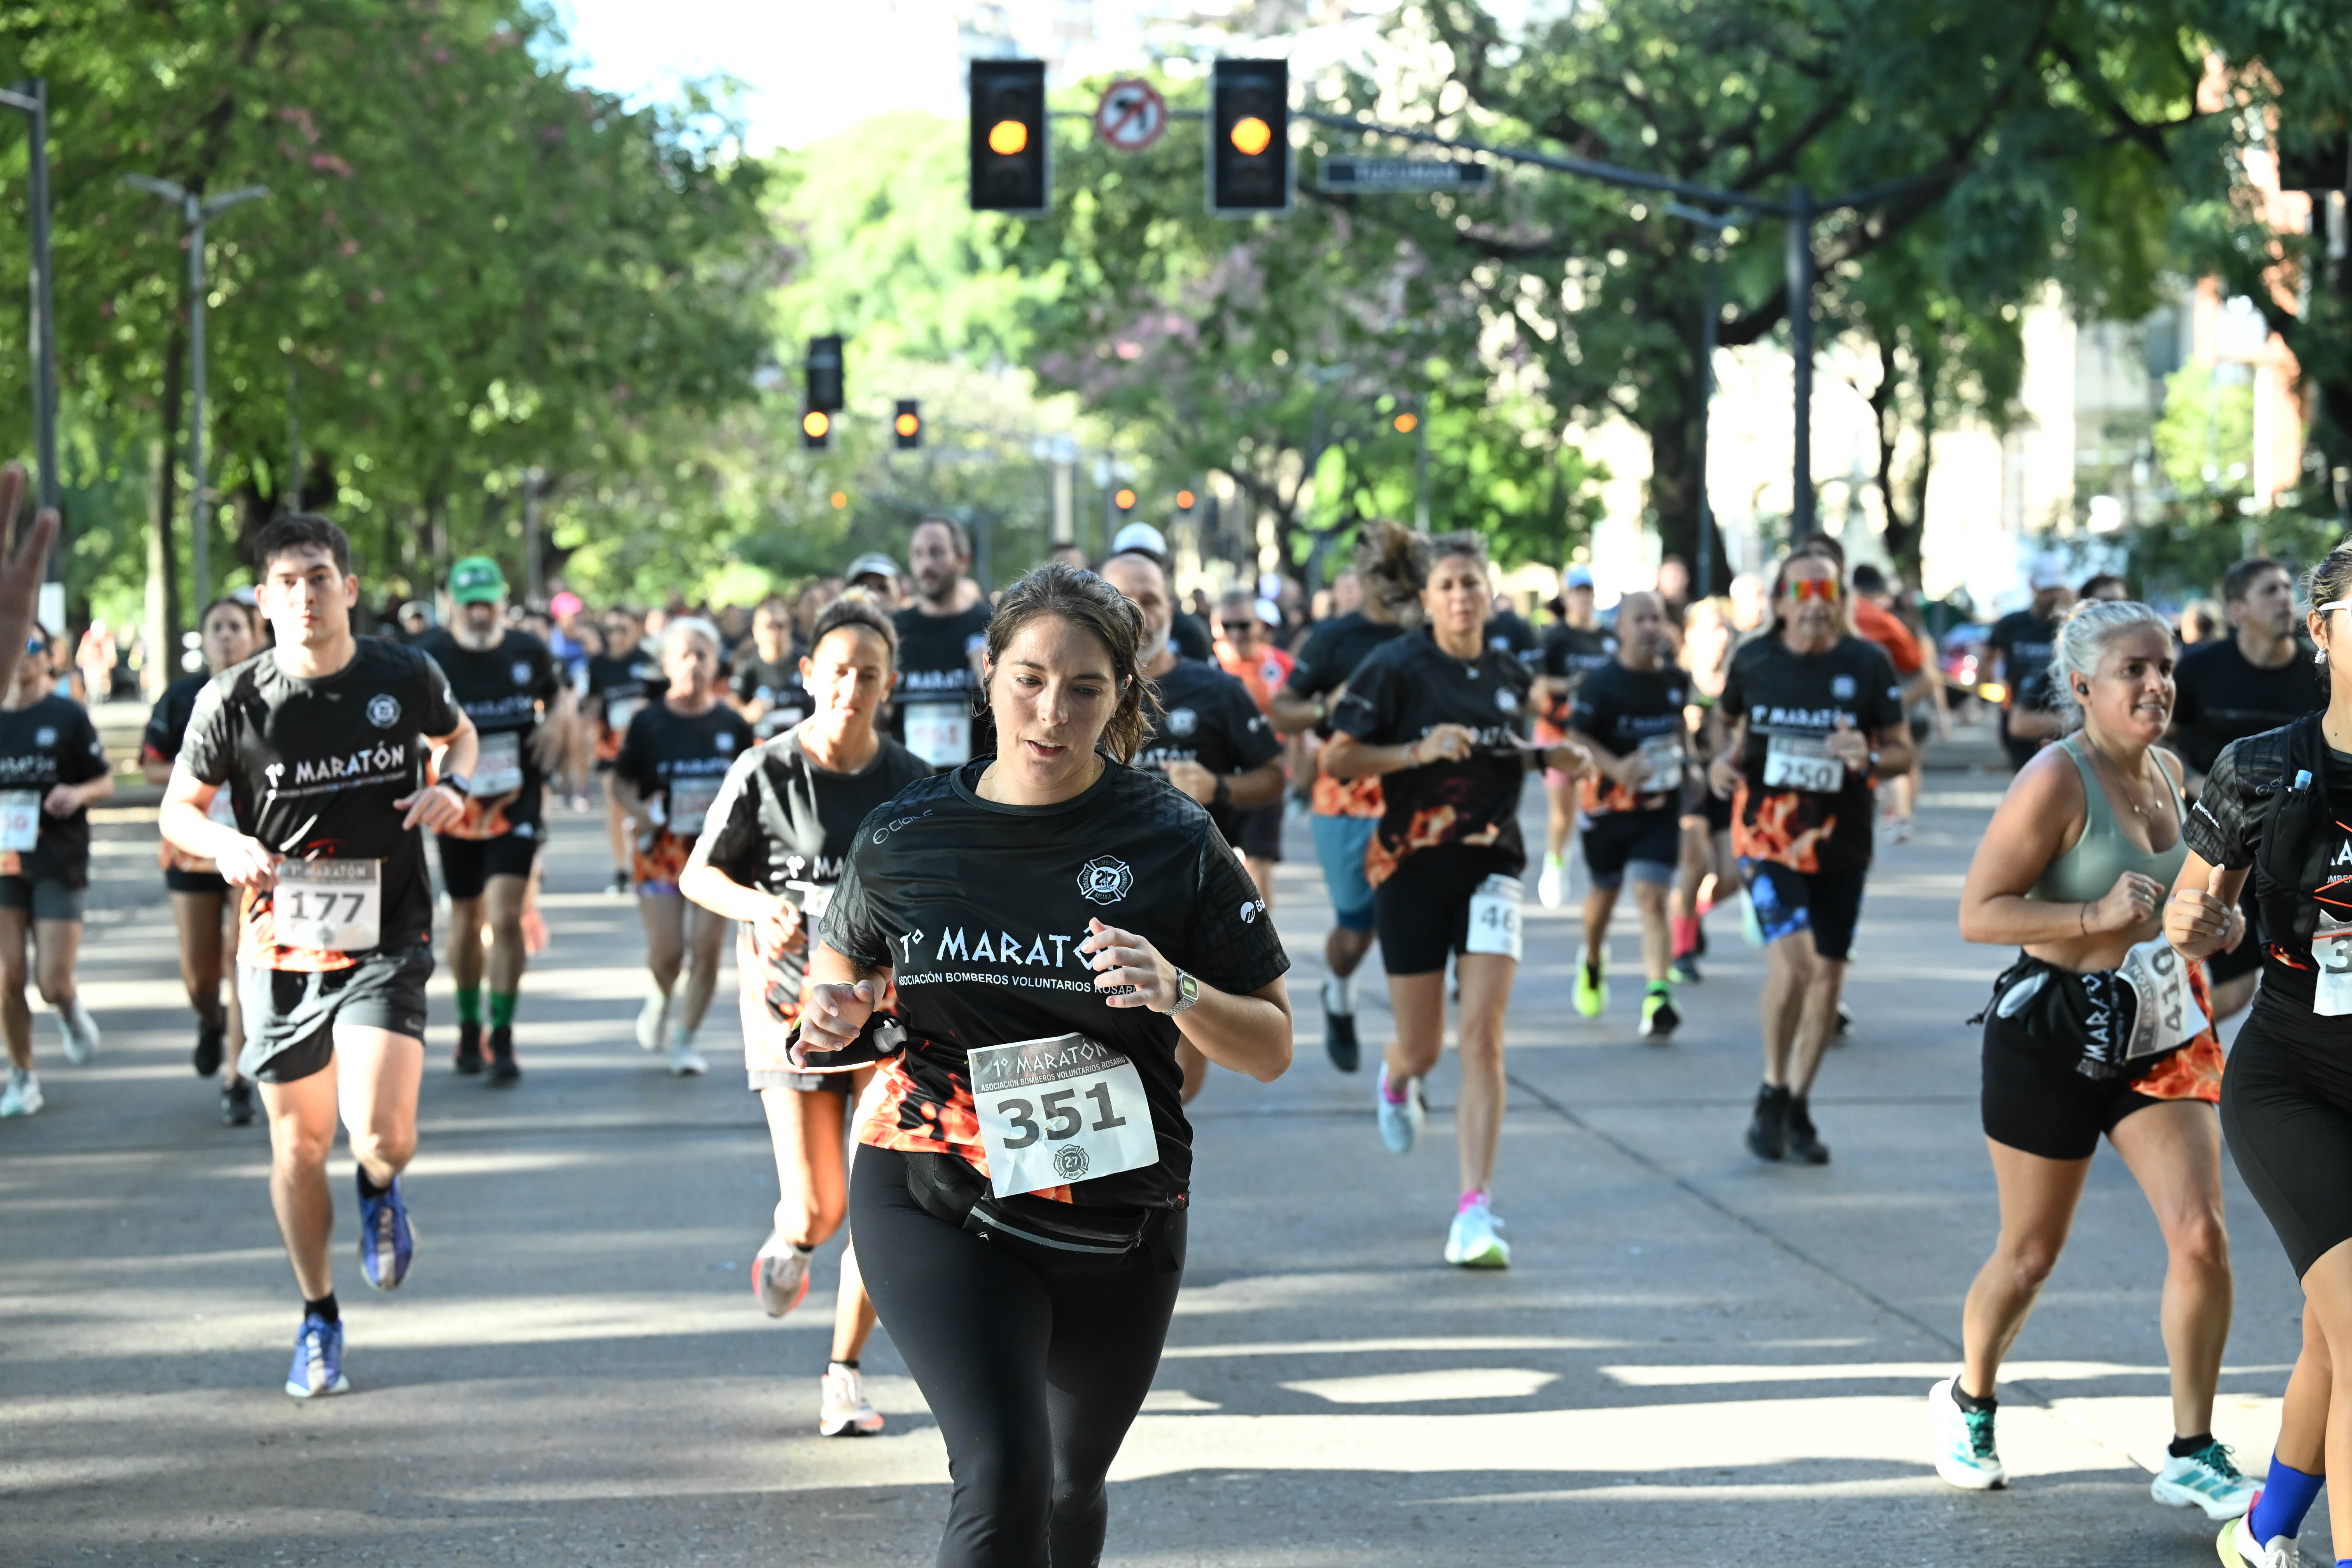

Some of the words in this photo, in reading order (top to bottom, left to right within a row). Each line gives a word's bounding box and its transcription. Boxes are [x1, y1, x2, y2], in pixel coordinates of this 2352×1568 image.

[295, 740, 404, 784] MARATÓN
[1095, 870, 1117, 886] 27
[290, 891, 365, 923] 177
[899, 971, 942, 986] ASOCIACIÓN
[945, 972, 1008, 985] BOMBEROS
[1012, 976, 1091, 992] VOLUNTARIOS
[1017, 1038, 1108, 1074] MARATÓN
[1020, 1073, 1055, 1086] BOMBEROS
[1057, 1065, 1101, 1080] VOLUNTARIOS
[1102, 1056, 1126, 1069] ROSARIO
[997, 1082, 1127, 1149] 351
[1064, 1156, 1078, 1168] 27
